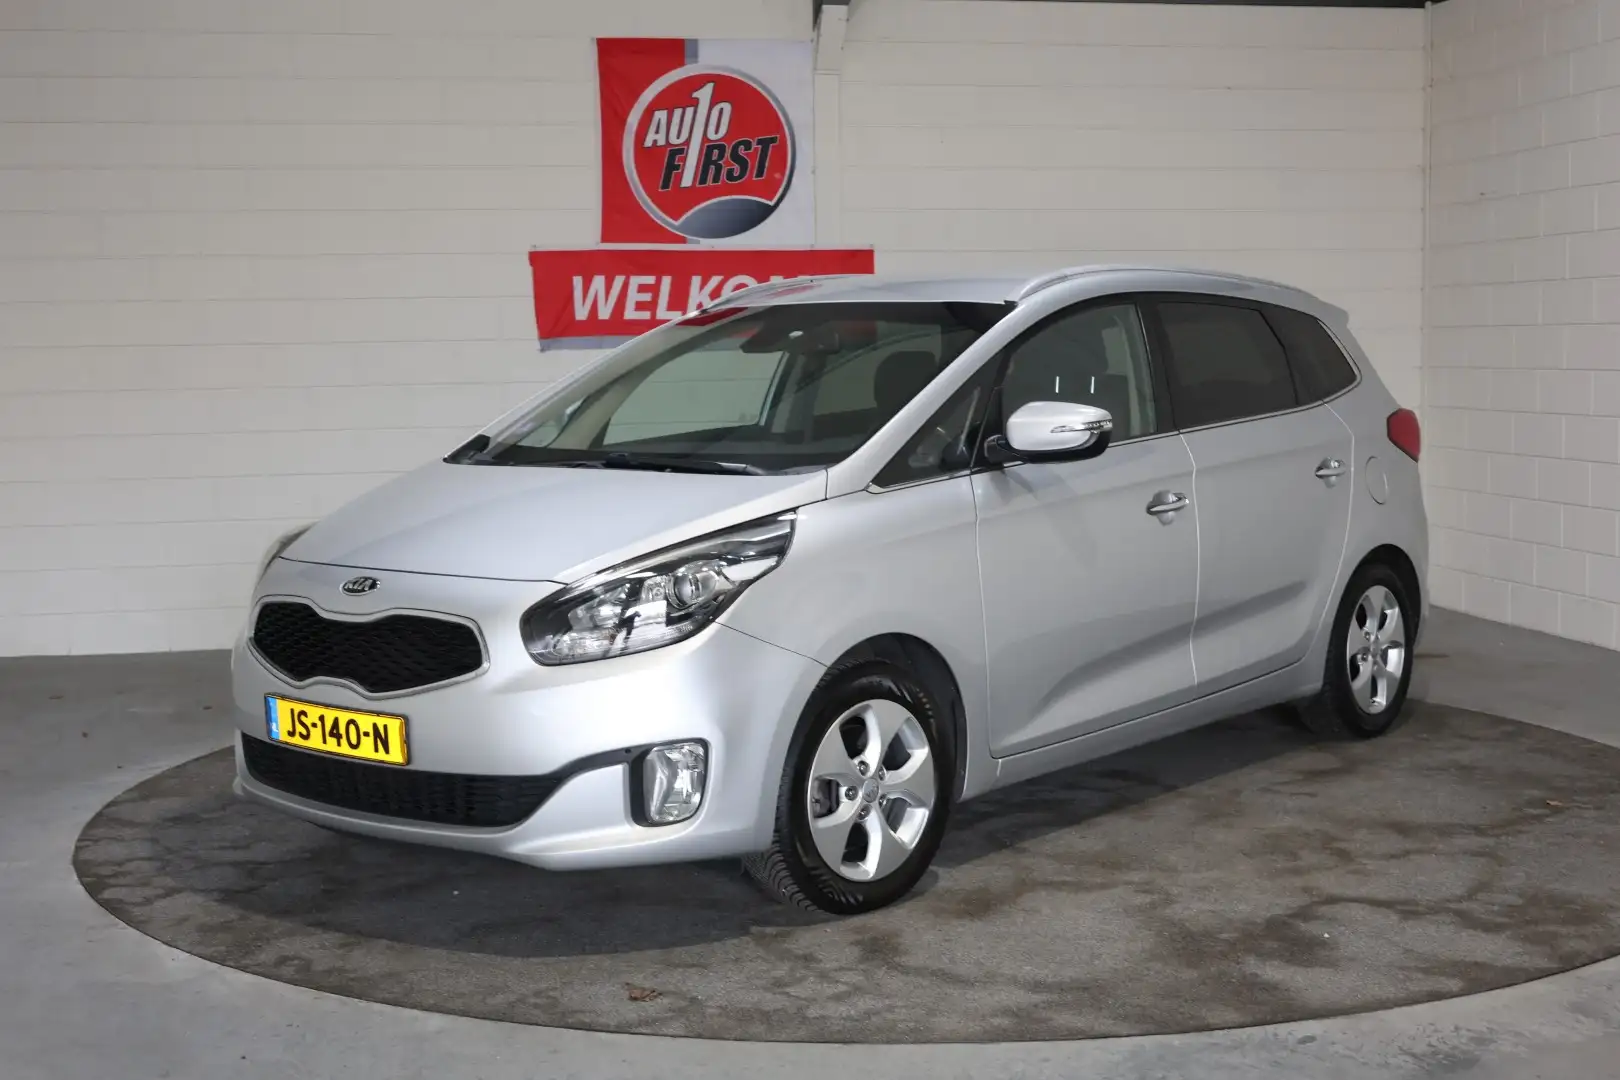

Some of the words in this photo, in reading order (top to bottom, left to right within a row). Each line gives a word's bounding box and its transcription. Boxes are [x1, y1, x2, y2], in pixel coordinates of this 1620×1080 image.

[572, 274, 812, 321] WELK
[343, 578, 373, 591] KIA
[287, 707, 391, 755] JS-140-N
